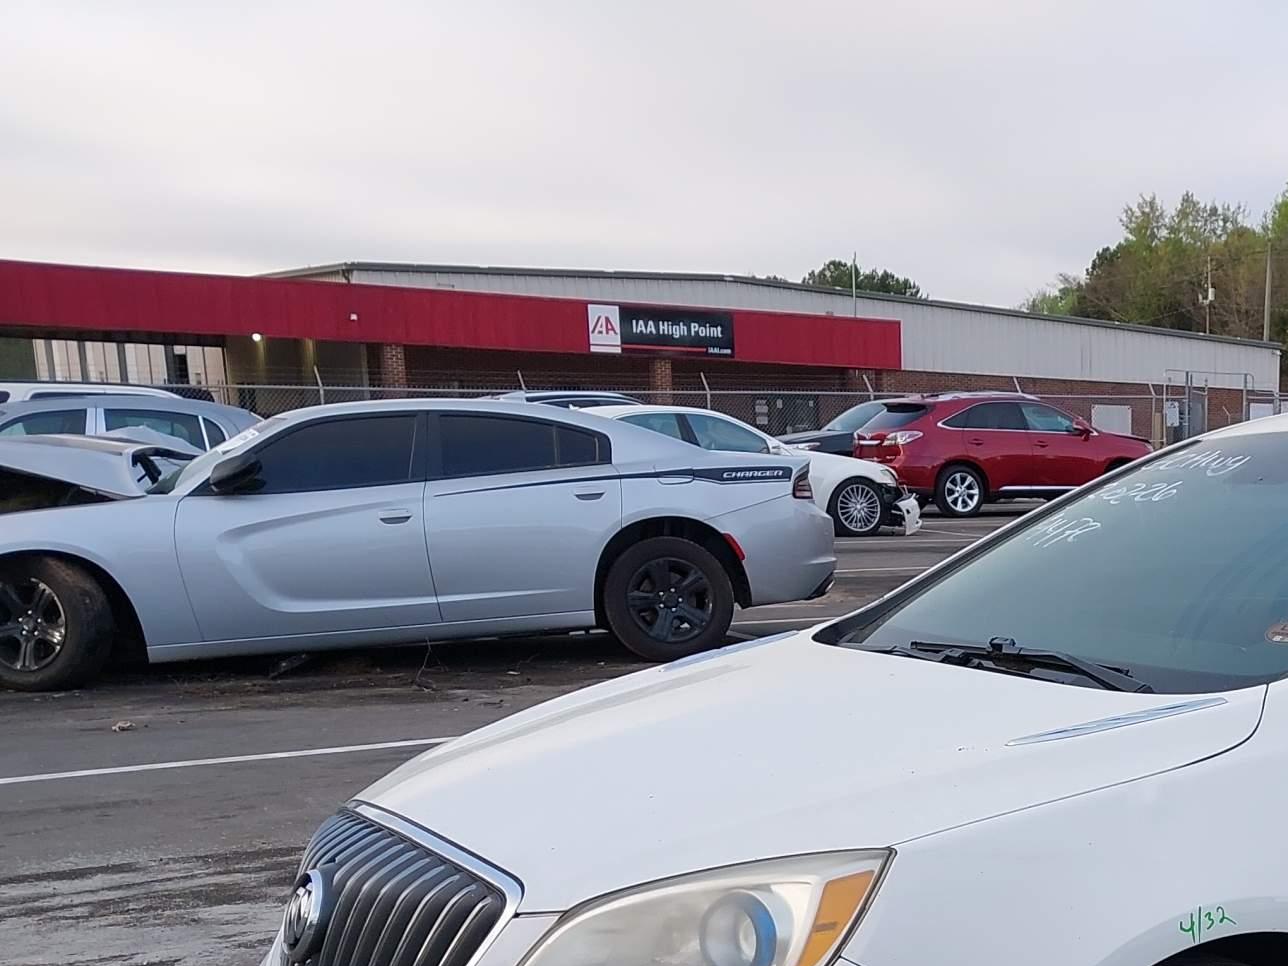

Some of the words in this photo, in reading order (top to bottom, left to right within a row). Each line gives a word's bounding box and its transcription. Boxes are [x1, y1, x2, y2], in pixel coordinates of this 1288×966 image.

[632, 319, 656, 335] IAA
[659, 321, 687, 338] High
[691, 323, 722, 338] Point
[722, 470, 783, 478] CHARGER
[1179, 905, 1237, 944] 4/32
